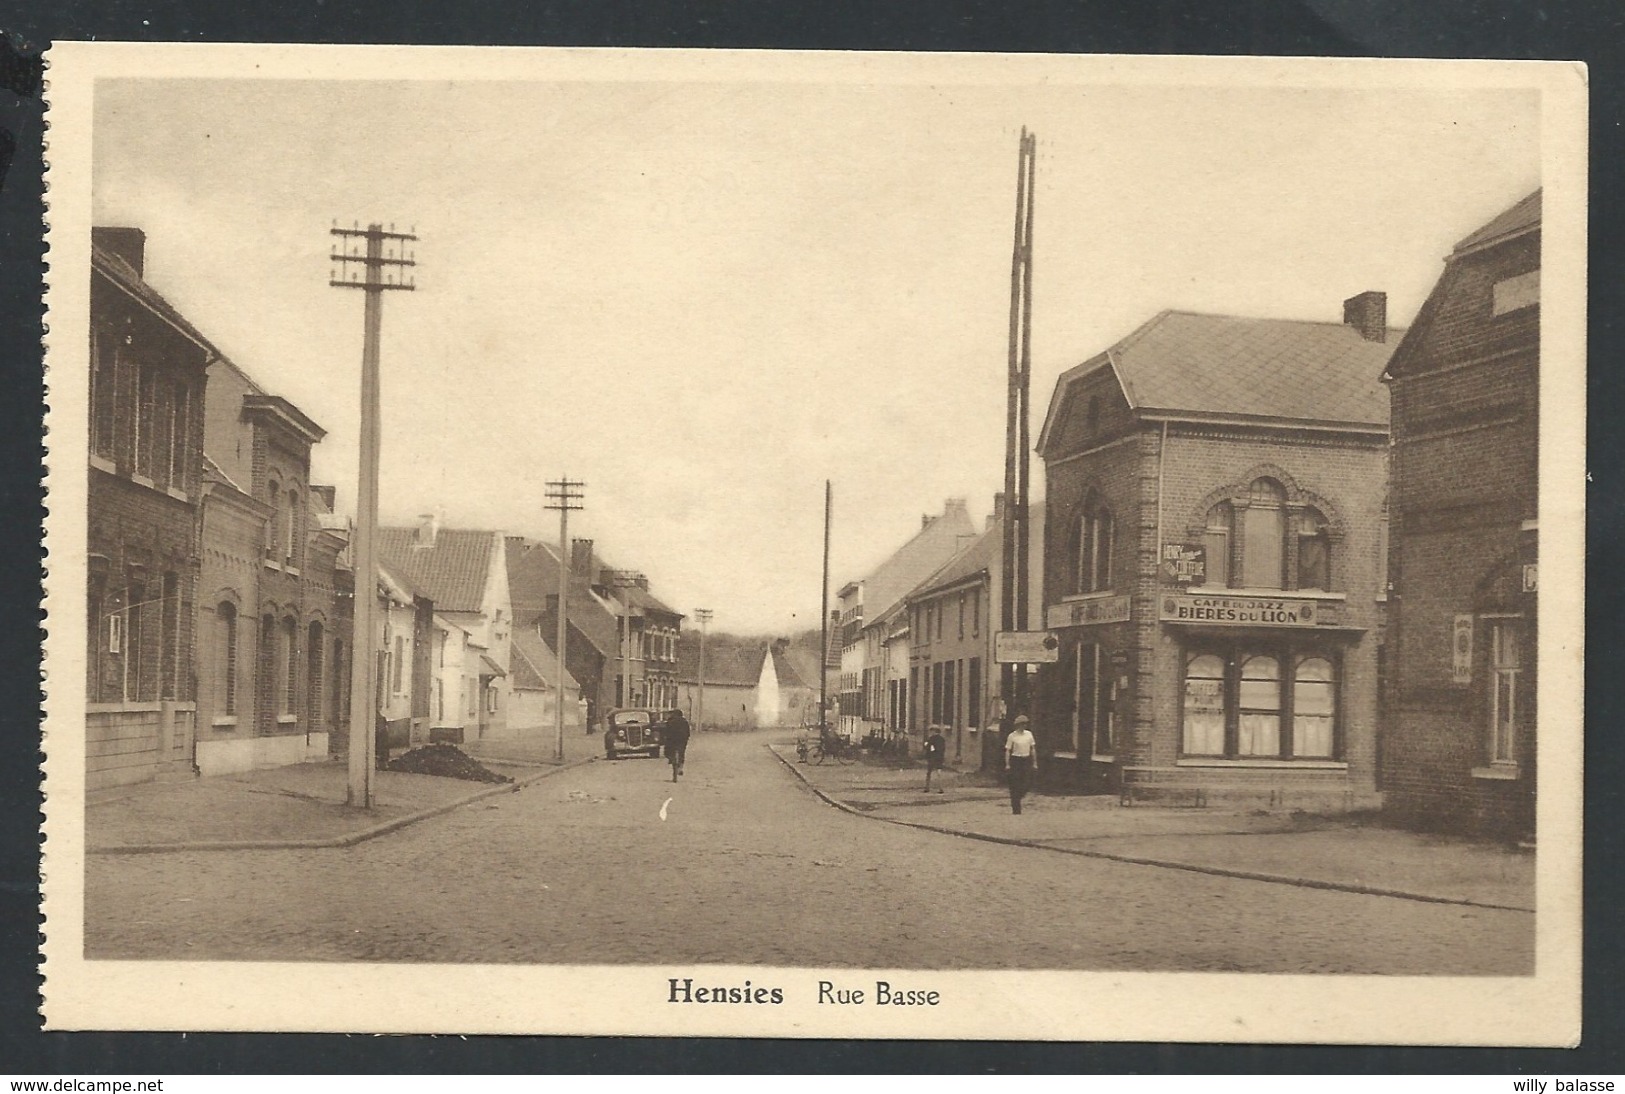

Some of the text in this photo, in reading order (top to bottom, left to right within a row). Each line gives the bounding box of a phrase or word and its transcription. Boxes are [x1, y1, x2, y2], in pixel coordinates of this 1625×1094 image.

[1193, 599, 1230, 608] CAFE
[1247, 602, 1284, 610] JAZZ
[1178, 606, 1297, 623] BIERES DU LION
